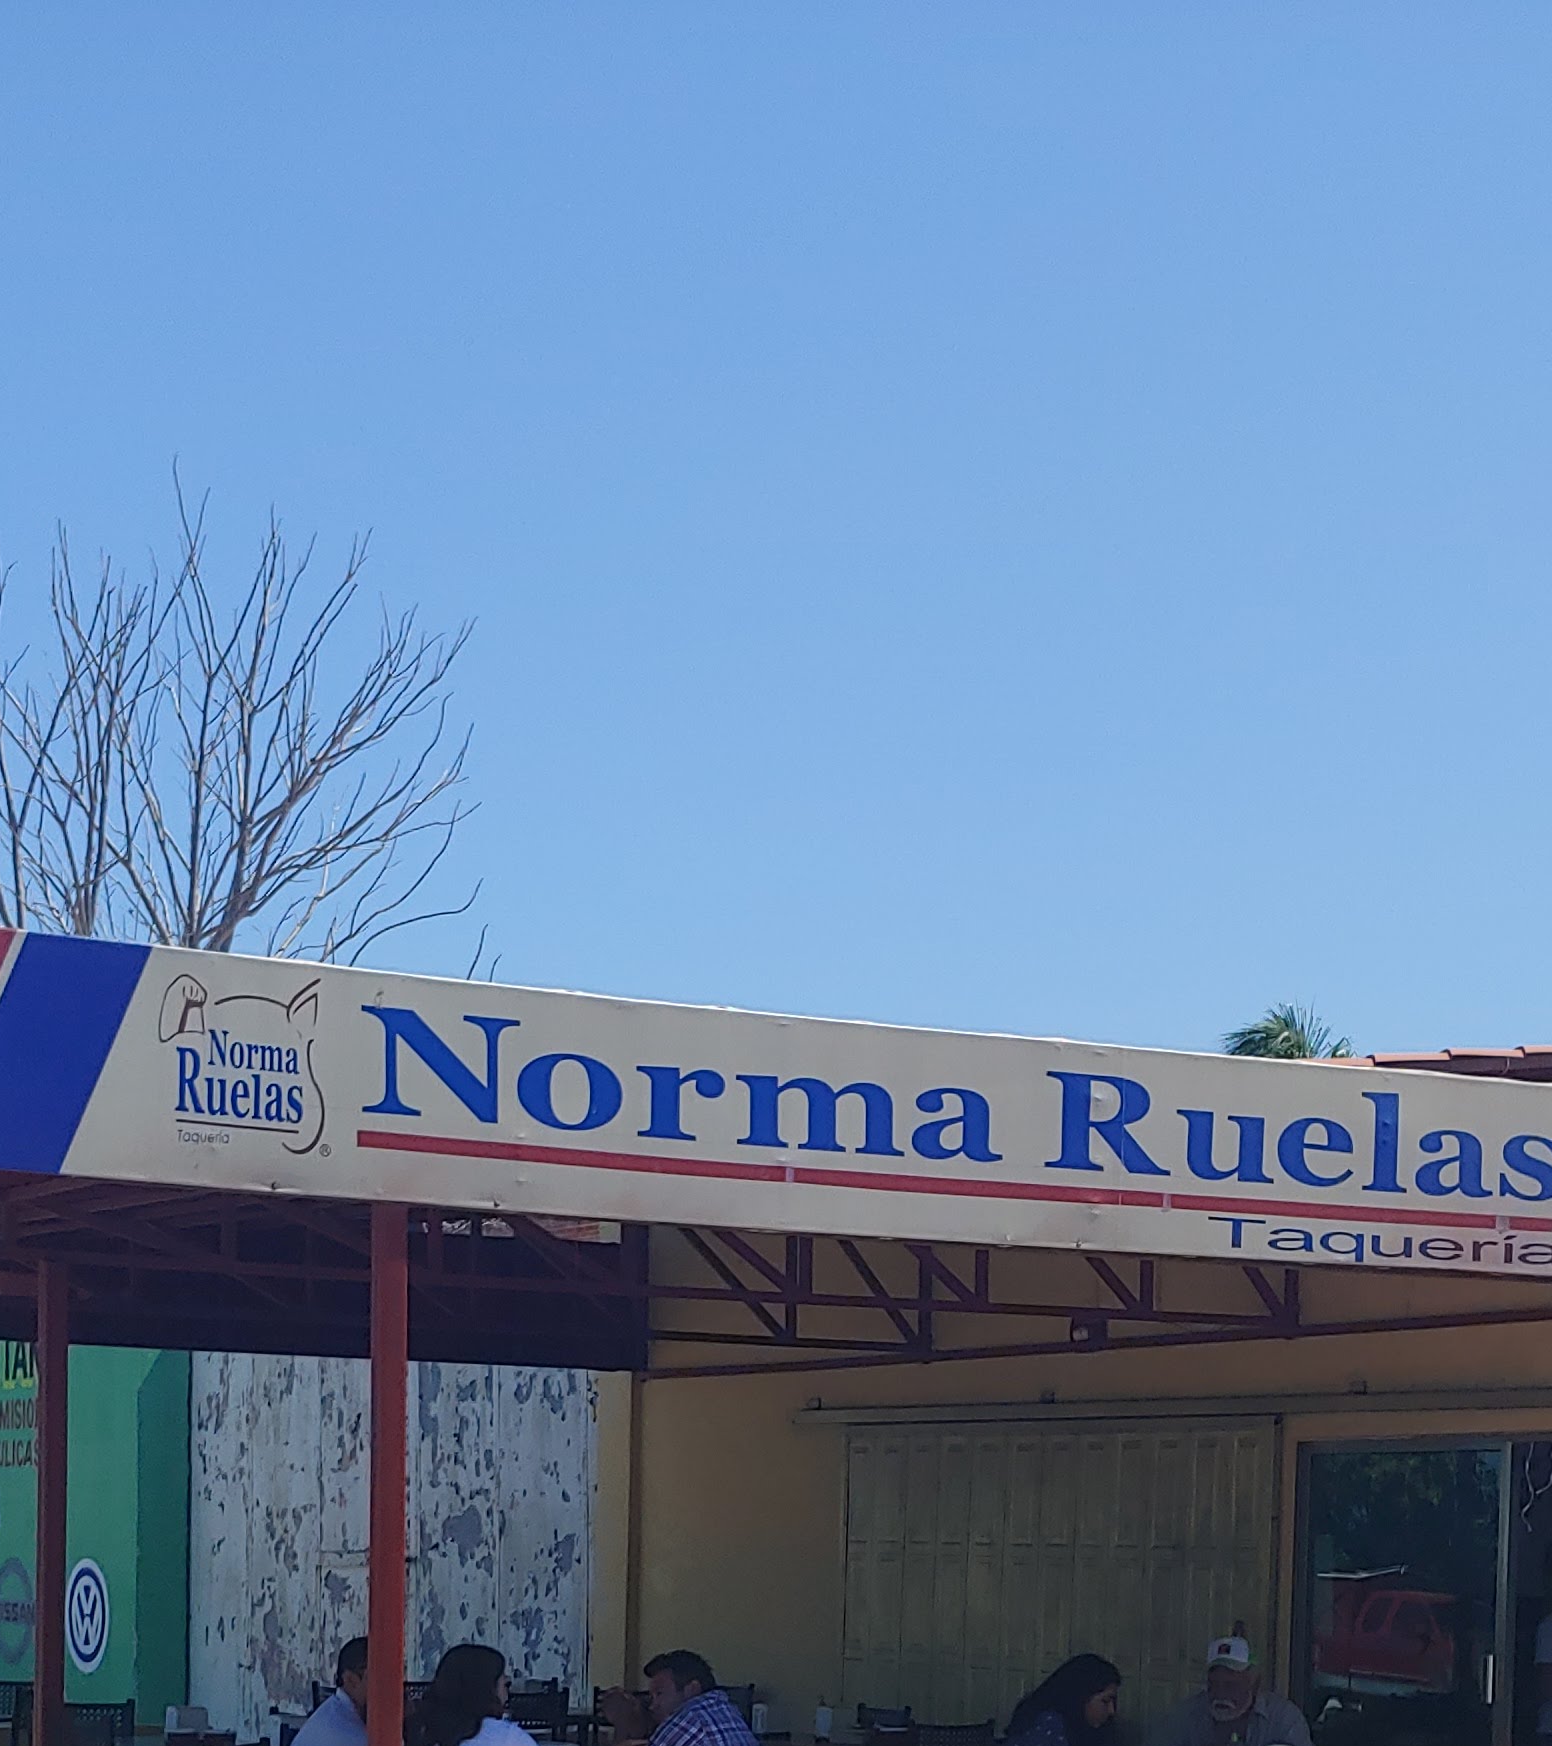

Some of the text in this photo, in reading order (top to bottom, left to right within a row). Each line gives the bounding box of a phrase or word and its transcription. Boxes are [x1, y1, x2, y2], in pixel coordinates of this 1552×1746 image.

[175, 1046, 304, 1124] Ruelas
[208, 1029, 300, 1075] Norma
[362, 1004, 1003, 1164] Norma
